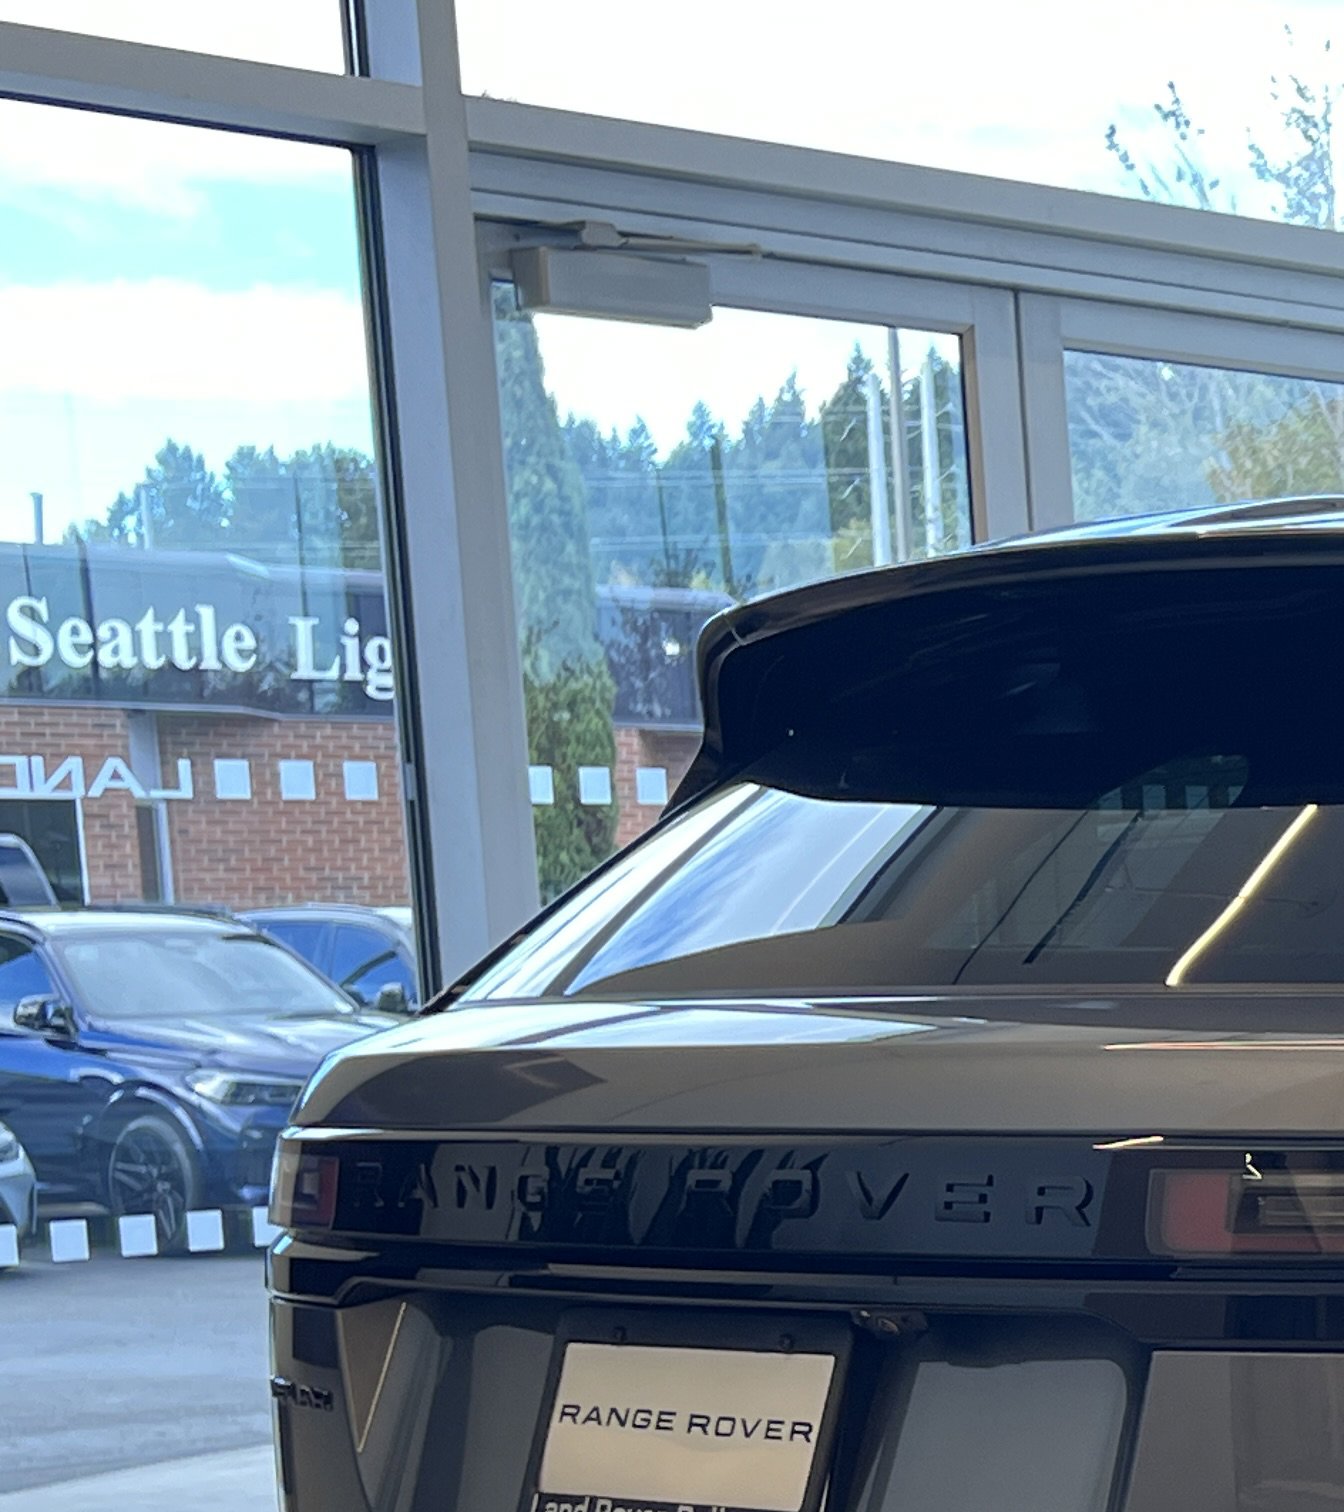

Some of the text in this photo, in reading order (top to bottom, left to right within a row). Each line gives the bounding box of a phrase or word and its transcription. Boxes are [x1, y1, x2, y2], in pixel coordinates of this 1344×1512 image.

[5, 595, 257, 672] Seattle
[351, 1160, 1095, 1228] RANGE ROVER
[558, 1404, 814, 1443] RANGE ROVER
